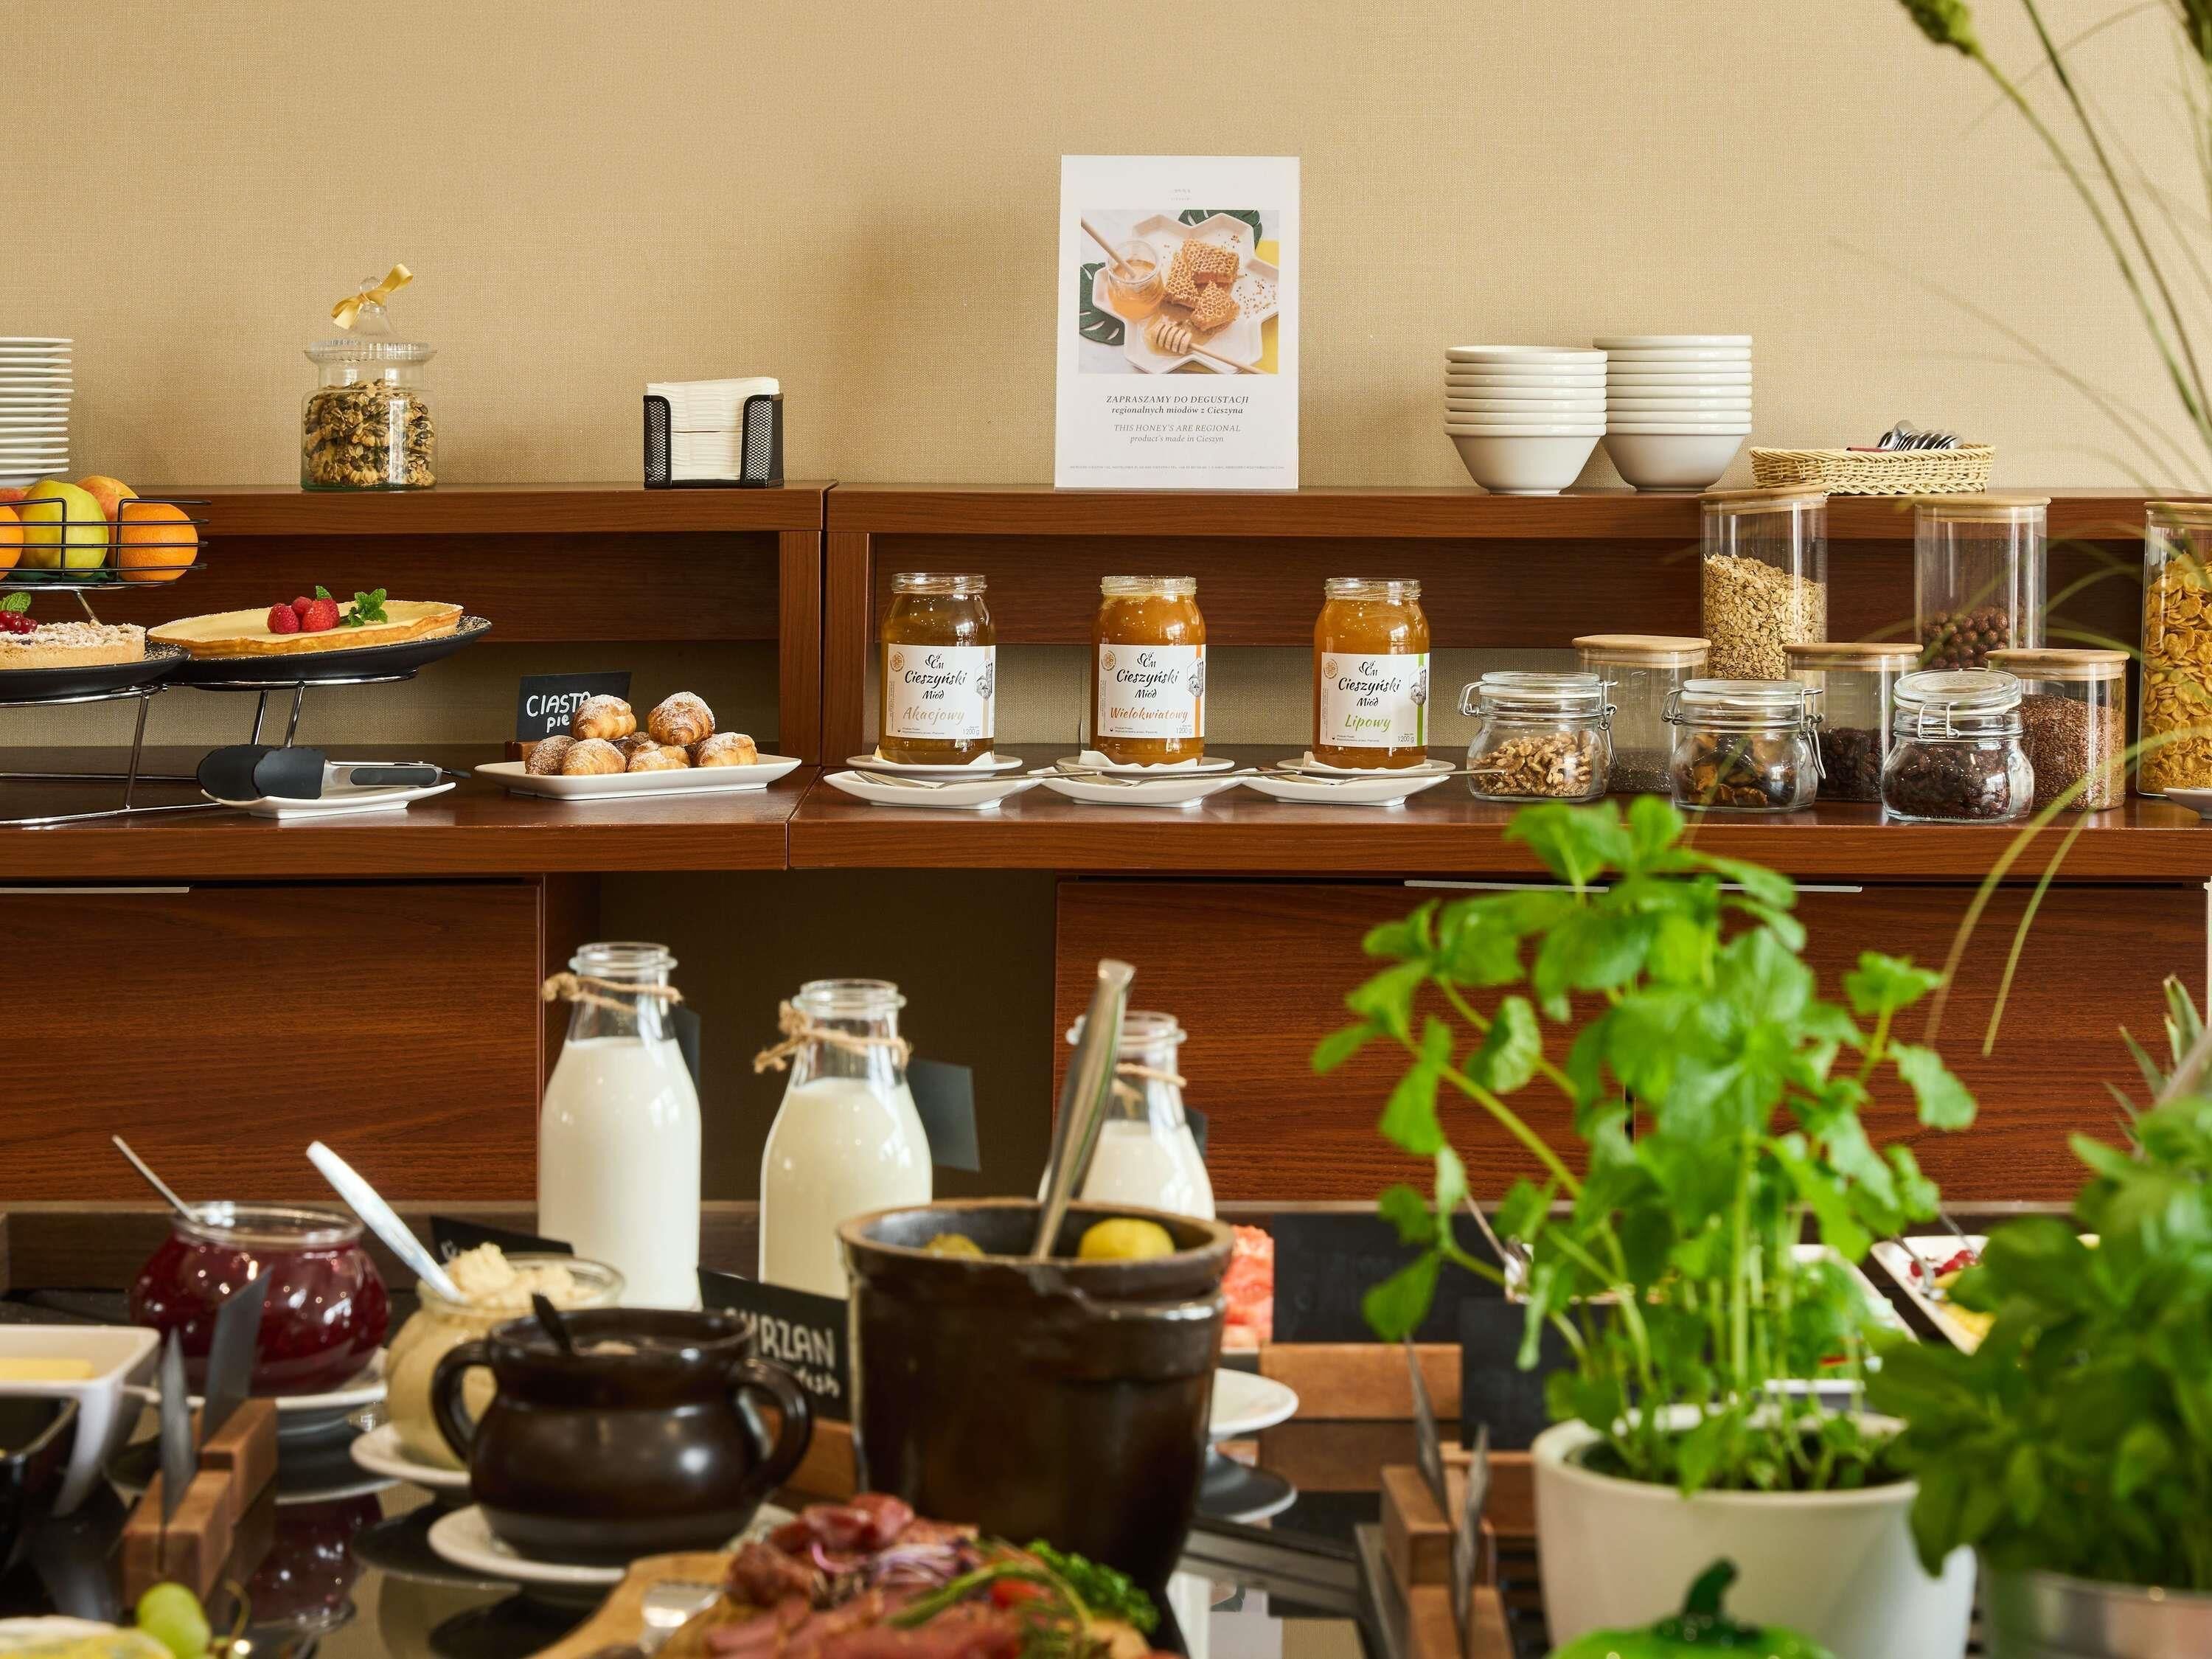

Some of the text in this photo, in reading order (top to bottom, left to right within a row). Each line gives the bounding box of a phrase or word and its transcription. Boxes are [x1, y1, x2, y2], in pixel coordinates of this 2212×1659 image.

[1105, 395, 1249, 405] ZAPRASZAMY DO DEGUSTACJI
[1111, 406, 1164, 415] regionalnych
[1166, 406, 1198, 414] miodów
[1208, 406, 1244, 416] Cieszyna
[1195, 424, 1241, 432] REGIONAL
[1165, 434, 1186, 442] made
[1187, 434, 1194, 442] in
[1196, 435, 1224, 444] Cieszyn
[905, 670, 967, 689] Cieszyński
[1117, 669, 1180, 687] Cieszyński
[1135, 689, 1157, 698] Miód
[1338, 678, 1402, 695] Cieszyński
[922, 690, 945, 700] Miód
[1357, 698, 1379, 707] Miód
[903, 706, 965, 725] Akacjowy
[1110, 707, 1189, 723] Wielokwiatowy
[1345, 714, 1391, 732] Lipowy
[546, 714, 570, 733] pie
[724, 1307, 835, 1368] RZAN
